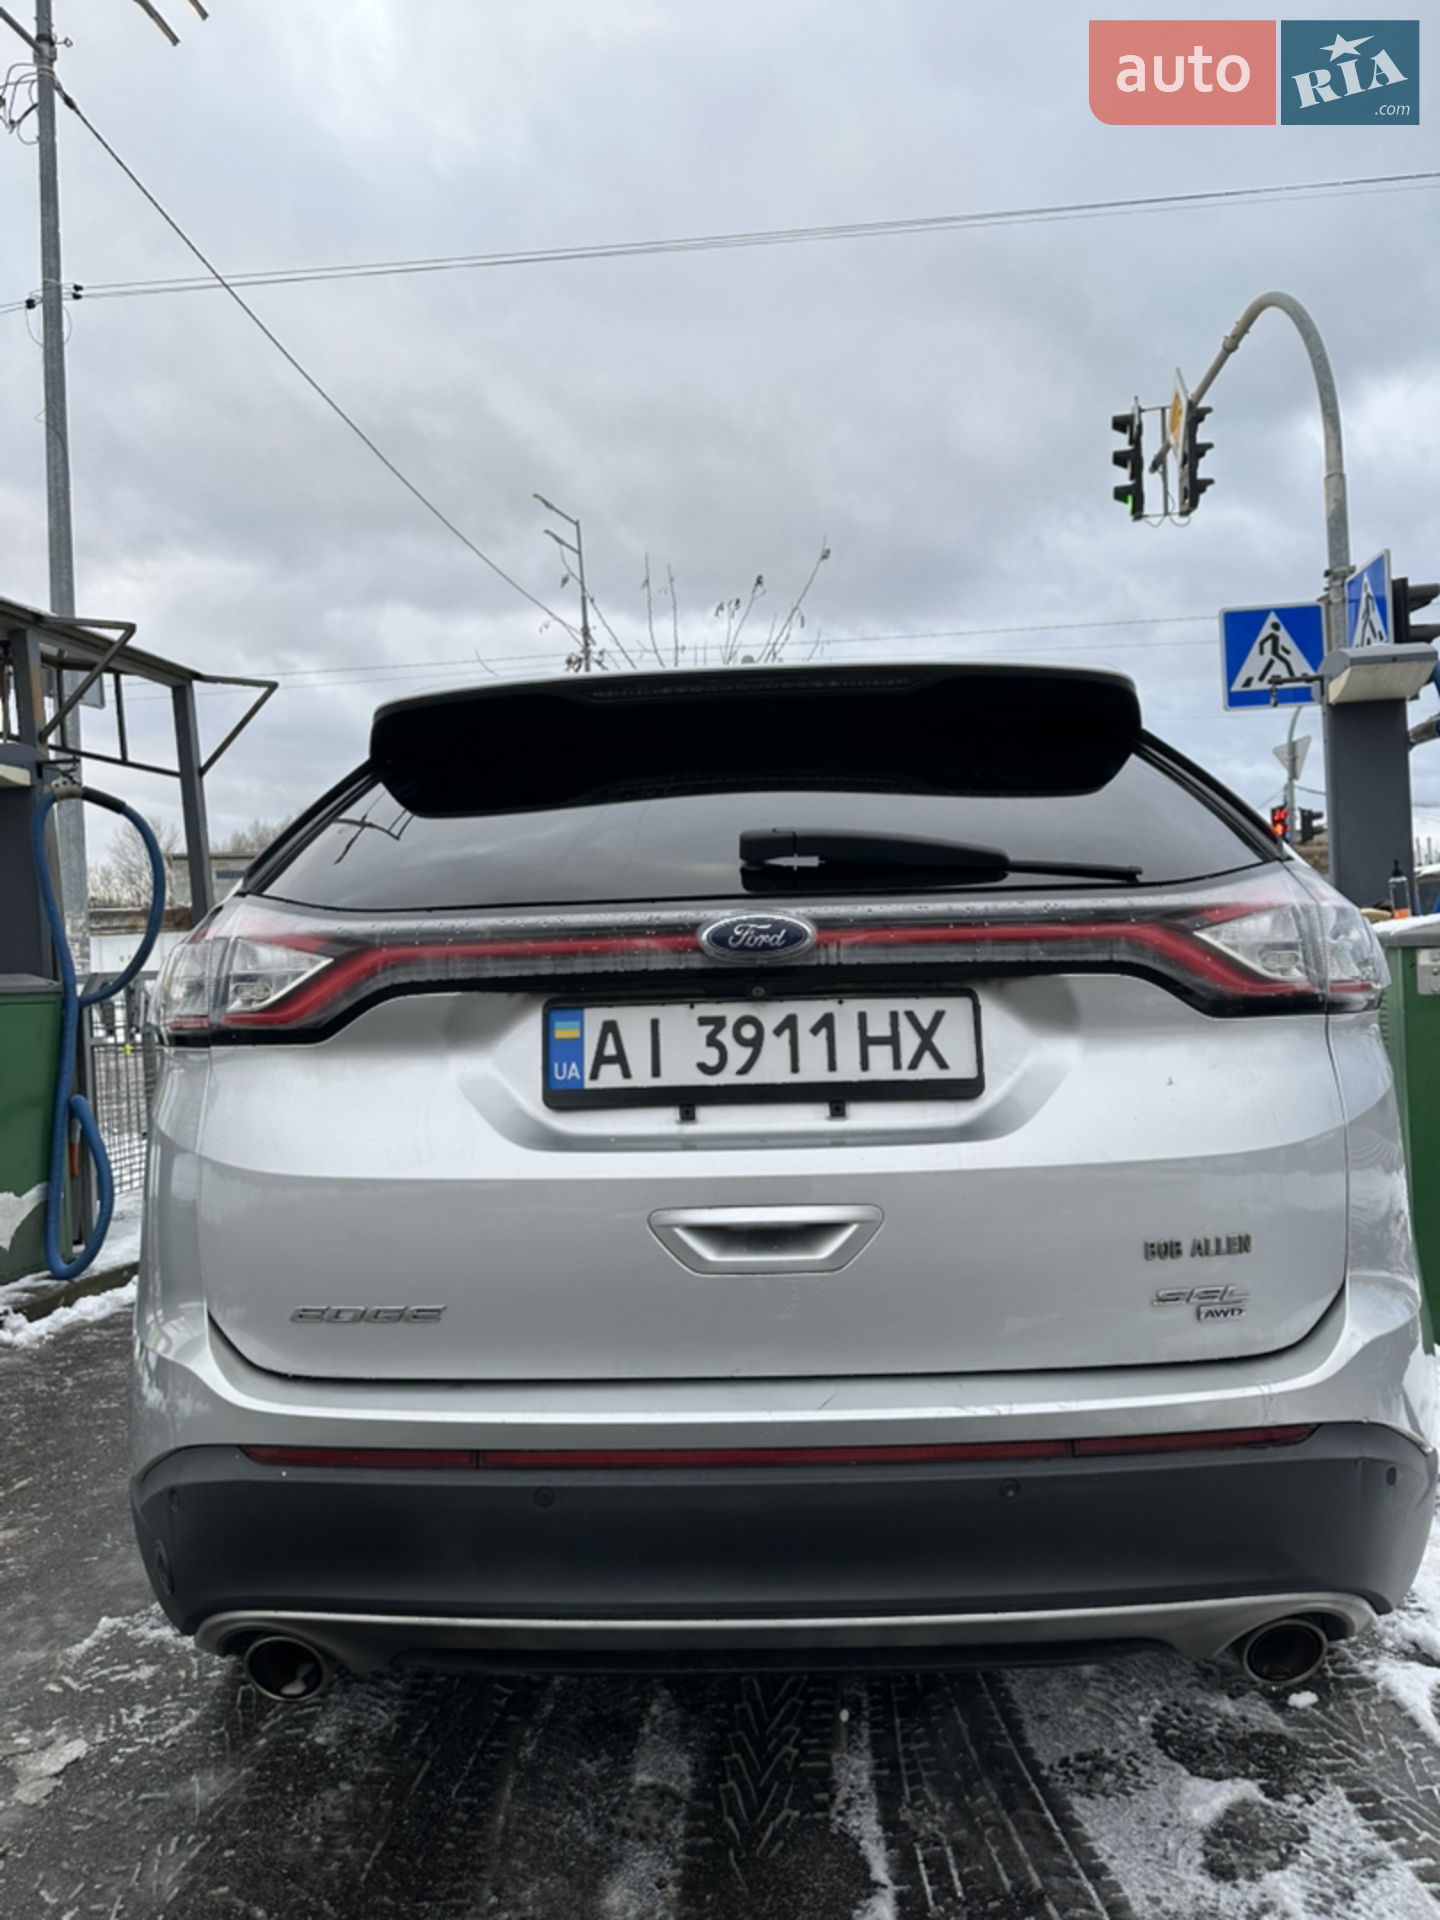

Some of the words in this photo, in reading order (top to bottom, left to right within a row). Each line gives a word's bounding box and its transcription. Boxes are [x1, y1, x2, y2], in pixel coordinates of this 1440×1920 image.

[728, 923, 787, 948] Ford
[589, 1018, 662, 1081] AI
[695, 1013, 838, 1076] 3911
[857, 1010, 950, 1072] HX
[554, 1062, 581, 1081] UA
[1144, 1240, 1183, 1261] BOB
[1190, 1233, 1252, 1257] ALLEN
[1152, 1285, 1252, 1306] SEL
[289, 1304, 448, 1324] EDGE
[1203, 1307, 1244, 1319] AWD
